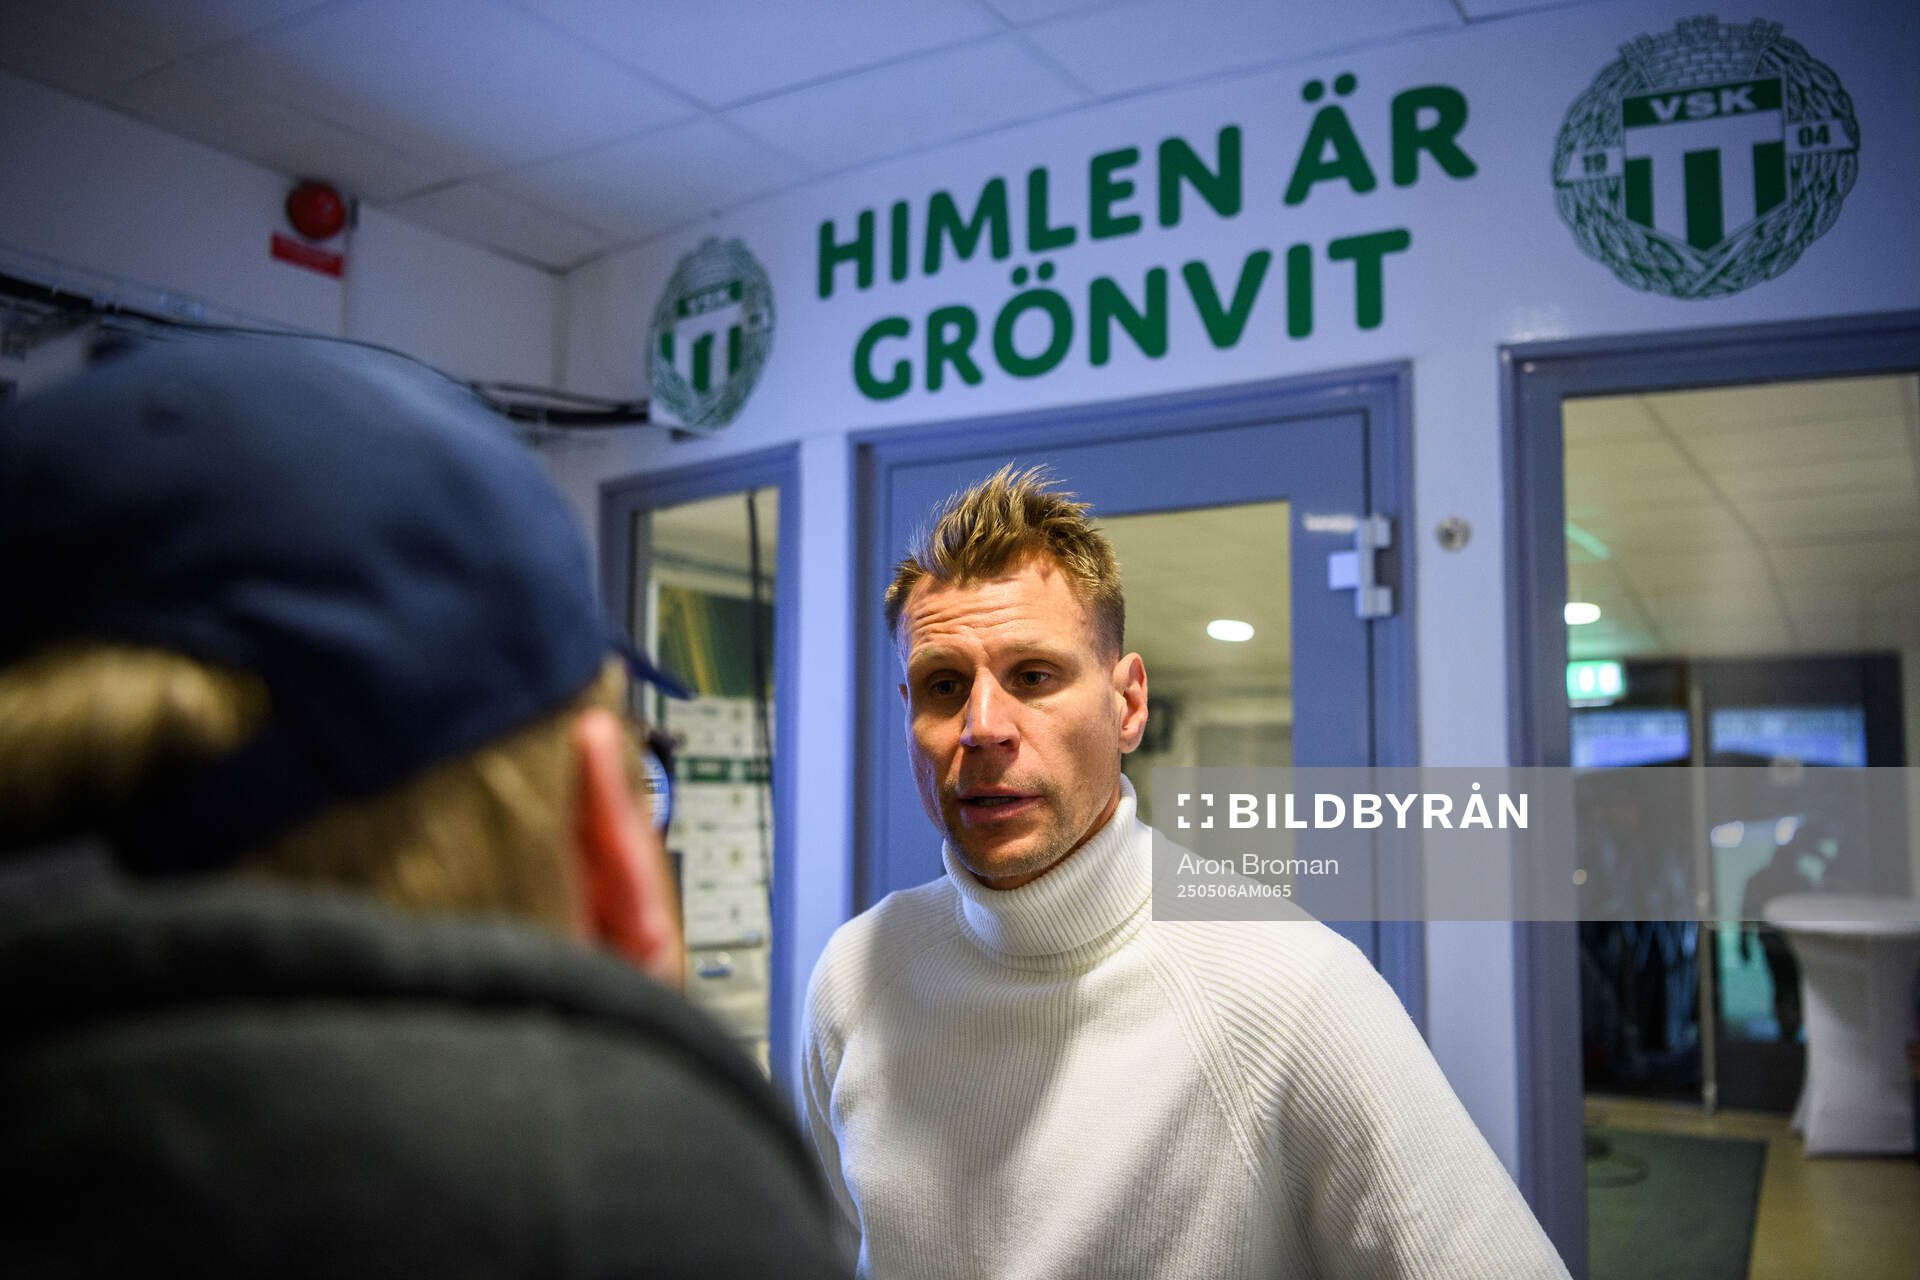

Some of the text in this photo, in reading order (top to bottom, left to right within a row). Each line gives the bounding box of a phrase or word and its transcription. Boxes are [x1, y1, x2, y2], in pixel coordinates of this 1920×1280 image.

[1651, 87, 1757, 121] VSK
[1798, 124, 1830, 147] 04
[818, 73, 1478, 300] HIMLEN ÄR
[853, 229, 1412, 400] GRÖNVIT
